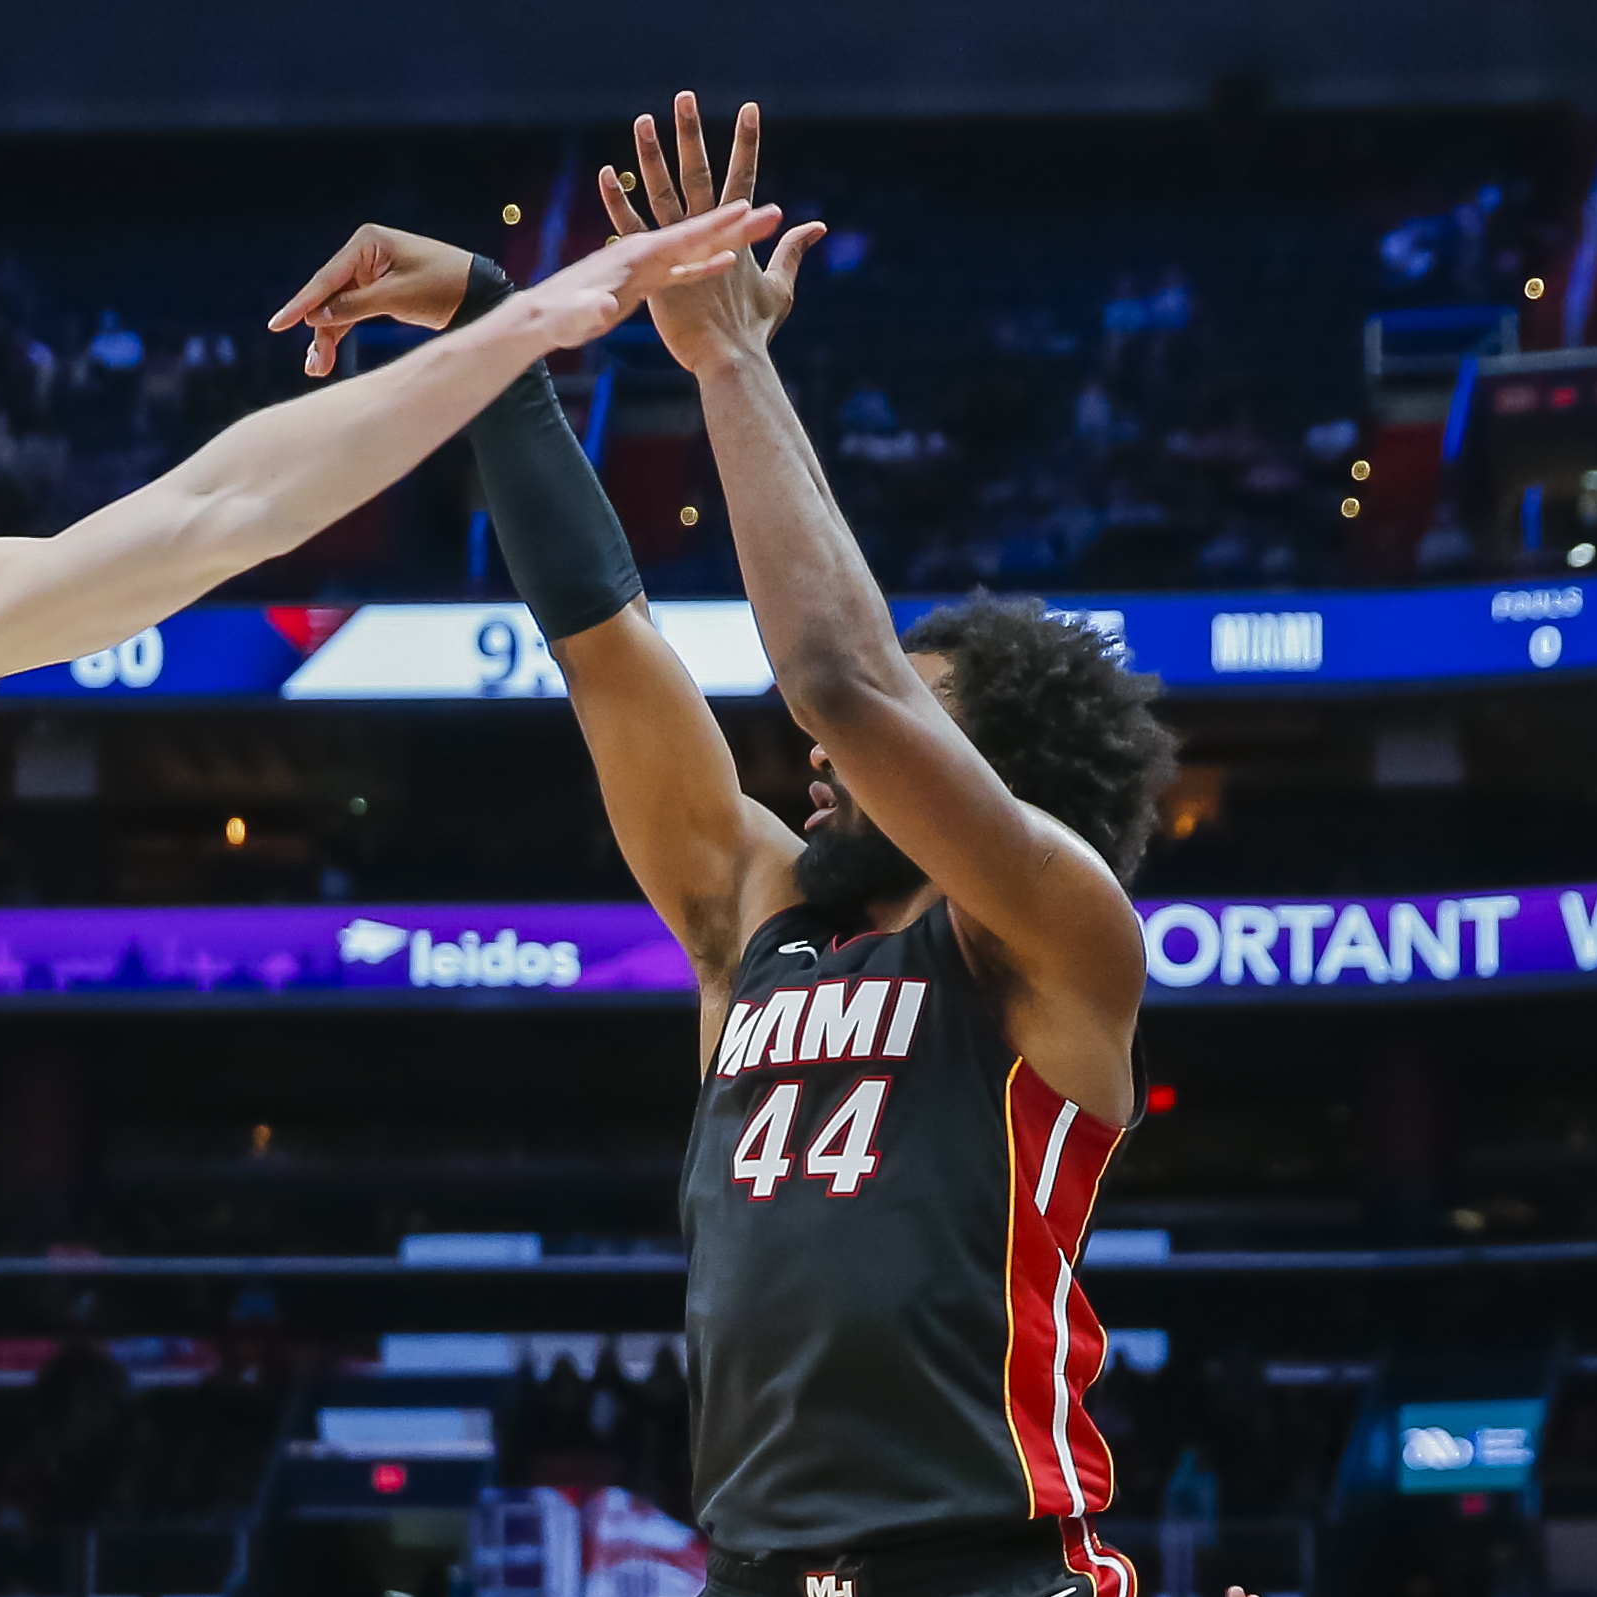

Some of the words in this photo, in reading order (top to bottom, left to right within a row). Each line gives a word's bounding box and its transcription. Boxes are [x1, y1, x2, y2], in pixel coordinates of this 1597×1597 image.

[408, 927, 583, 989] leidos
[1141, 894, 1522, 989] ORTANT
[731, 1076, 890, 1201] 44
